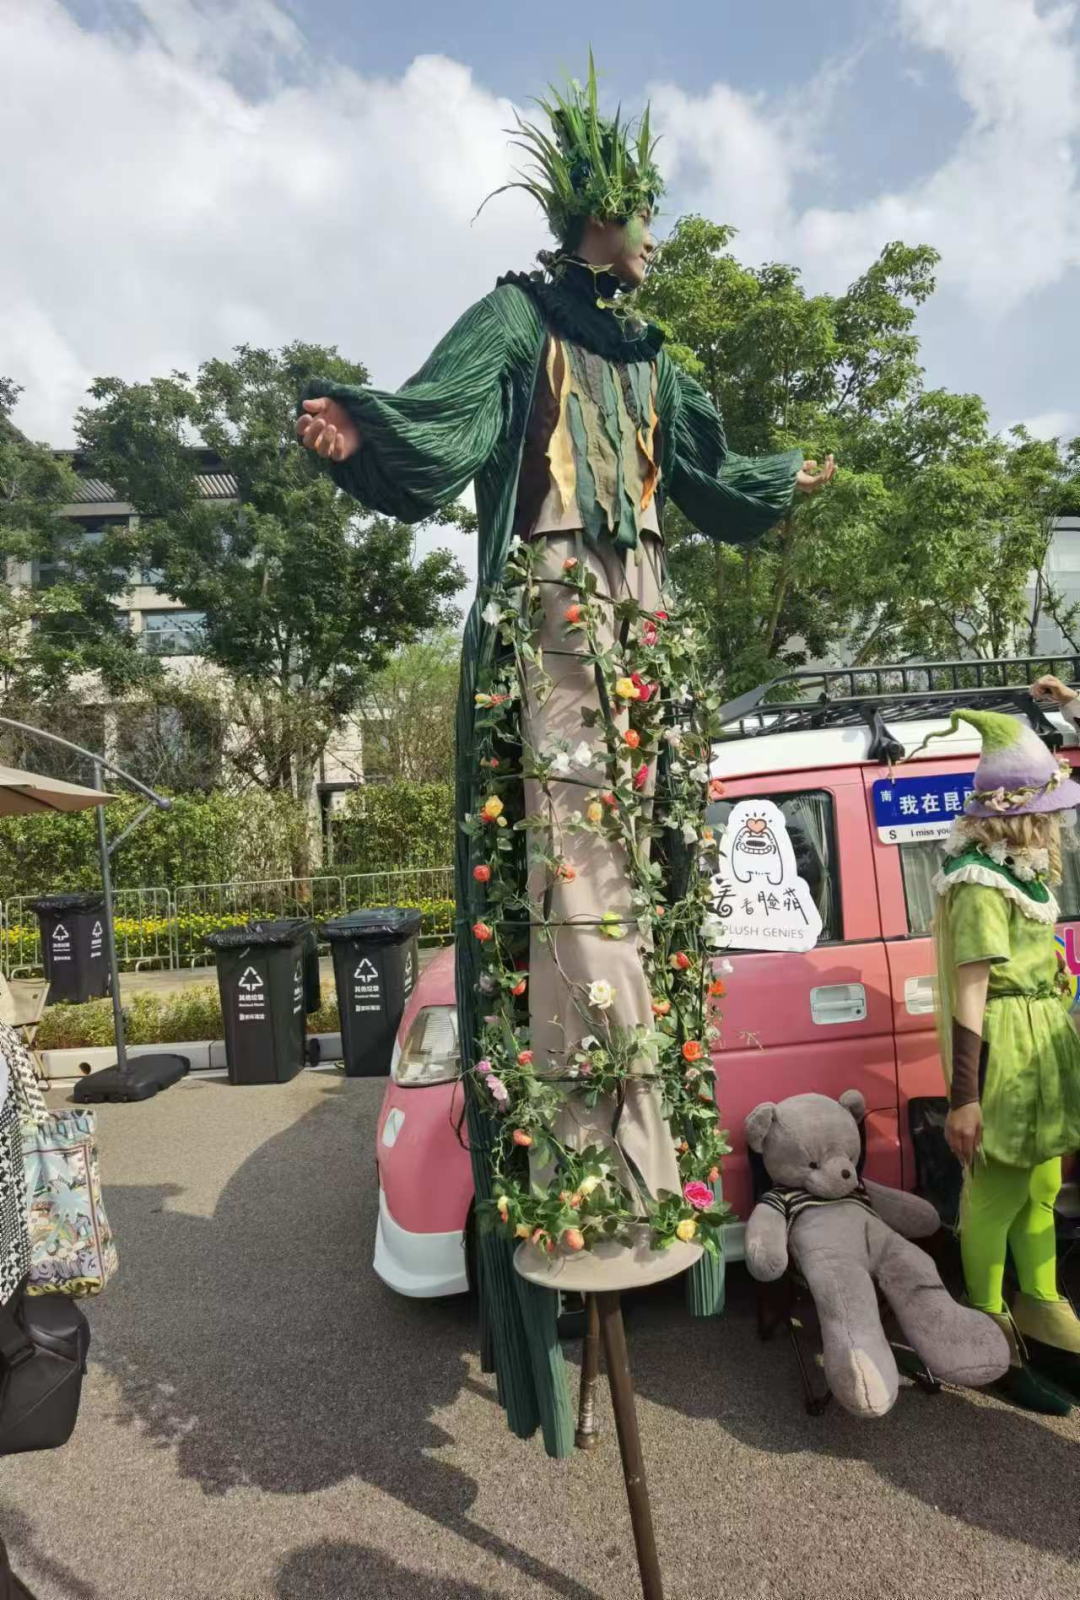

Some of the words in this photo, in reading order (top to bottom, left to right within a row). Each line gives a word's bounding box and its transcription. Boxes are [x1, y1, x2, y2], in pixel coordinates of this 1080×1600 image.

[880, 790, 892, 802] 南
[889, 830, 897, 840] S
[915, 829, 934, 837] miss
[721, 924, 759, 936] PLUSH
[762, 927, 804, 940] GENIES
